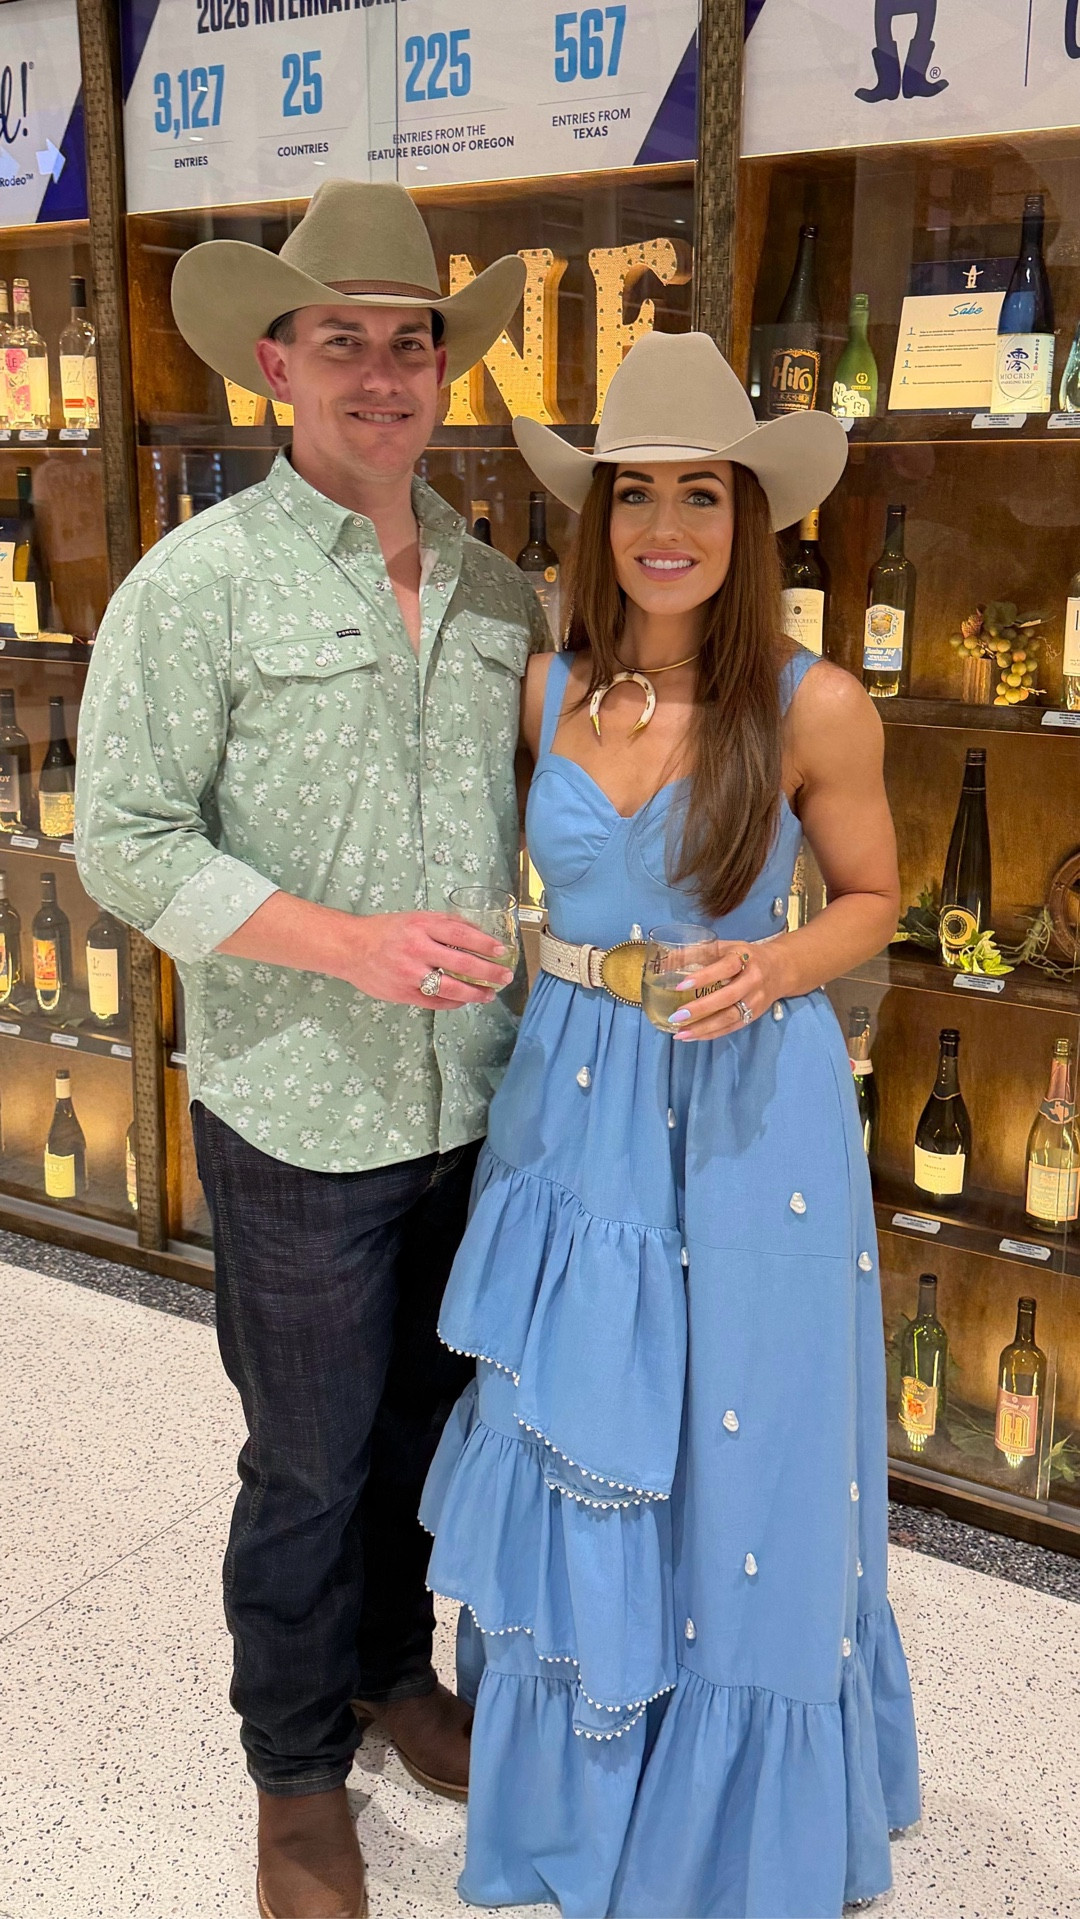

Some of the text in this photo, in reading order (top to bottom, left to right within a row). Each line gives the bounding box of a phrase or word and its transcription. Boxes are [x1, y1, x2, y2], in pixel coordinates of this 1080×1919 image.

[196, 0, 249, 34] 2026
[554, 5, 627, 83] 567
[405, 29, 471, 102] 225
[282, 50, 323, 118] 25
[154, 64, 225, 139] 3,127
[552, 108, 631, 128] ENTRIES FROM
[393, 124, 487, 145] ENTRIES FROM THE
[573, 126, 609, 140] TEXAS
[277, 142, 330, 158] COUNTRIES
[368, 135, 515, 161] FEATURE REGION OF OREGON
[174, 156, 209, 169] ENTRIES
[948, 301, 984, 317] Sake
[772, 355, 813, 392] Hiro
